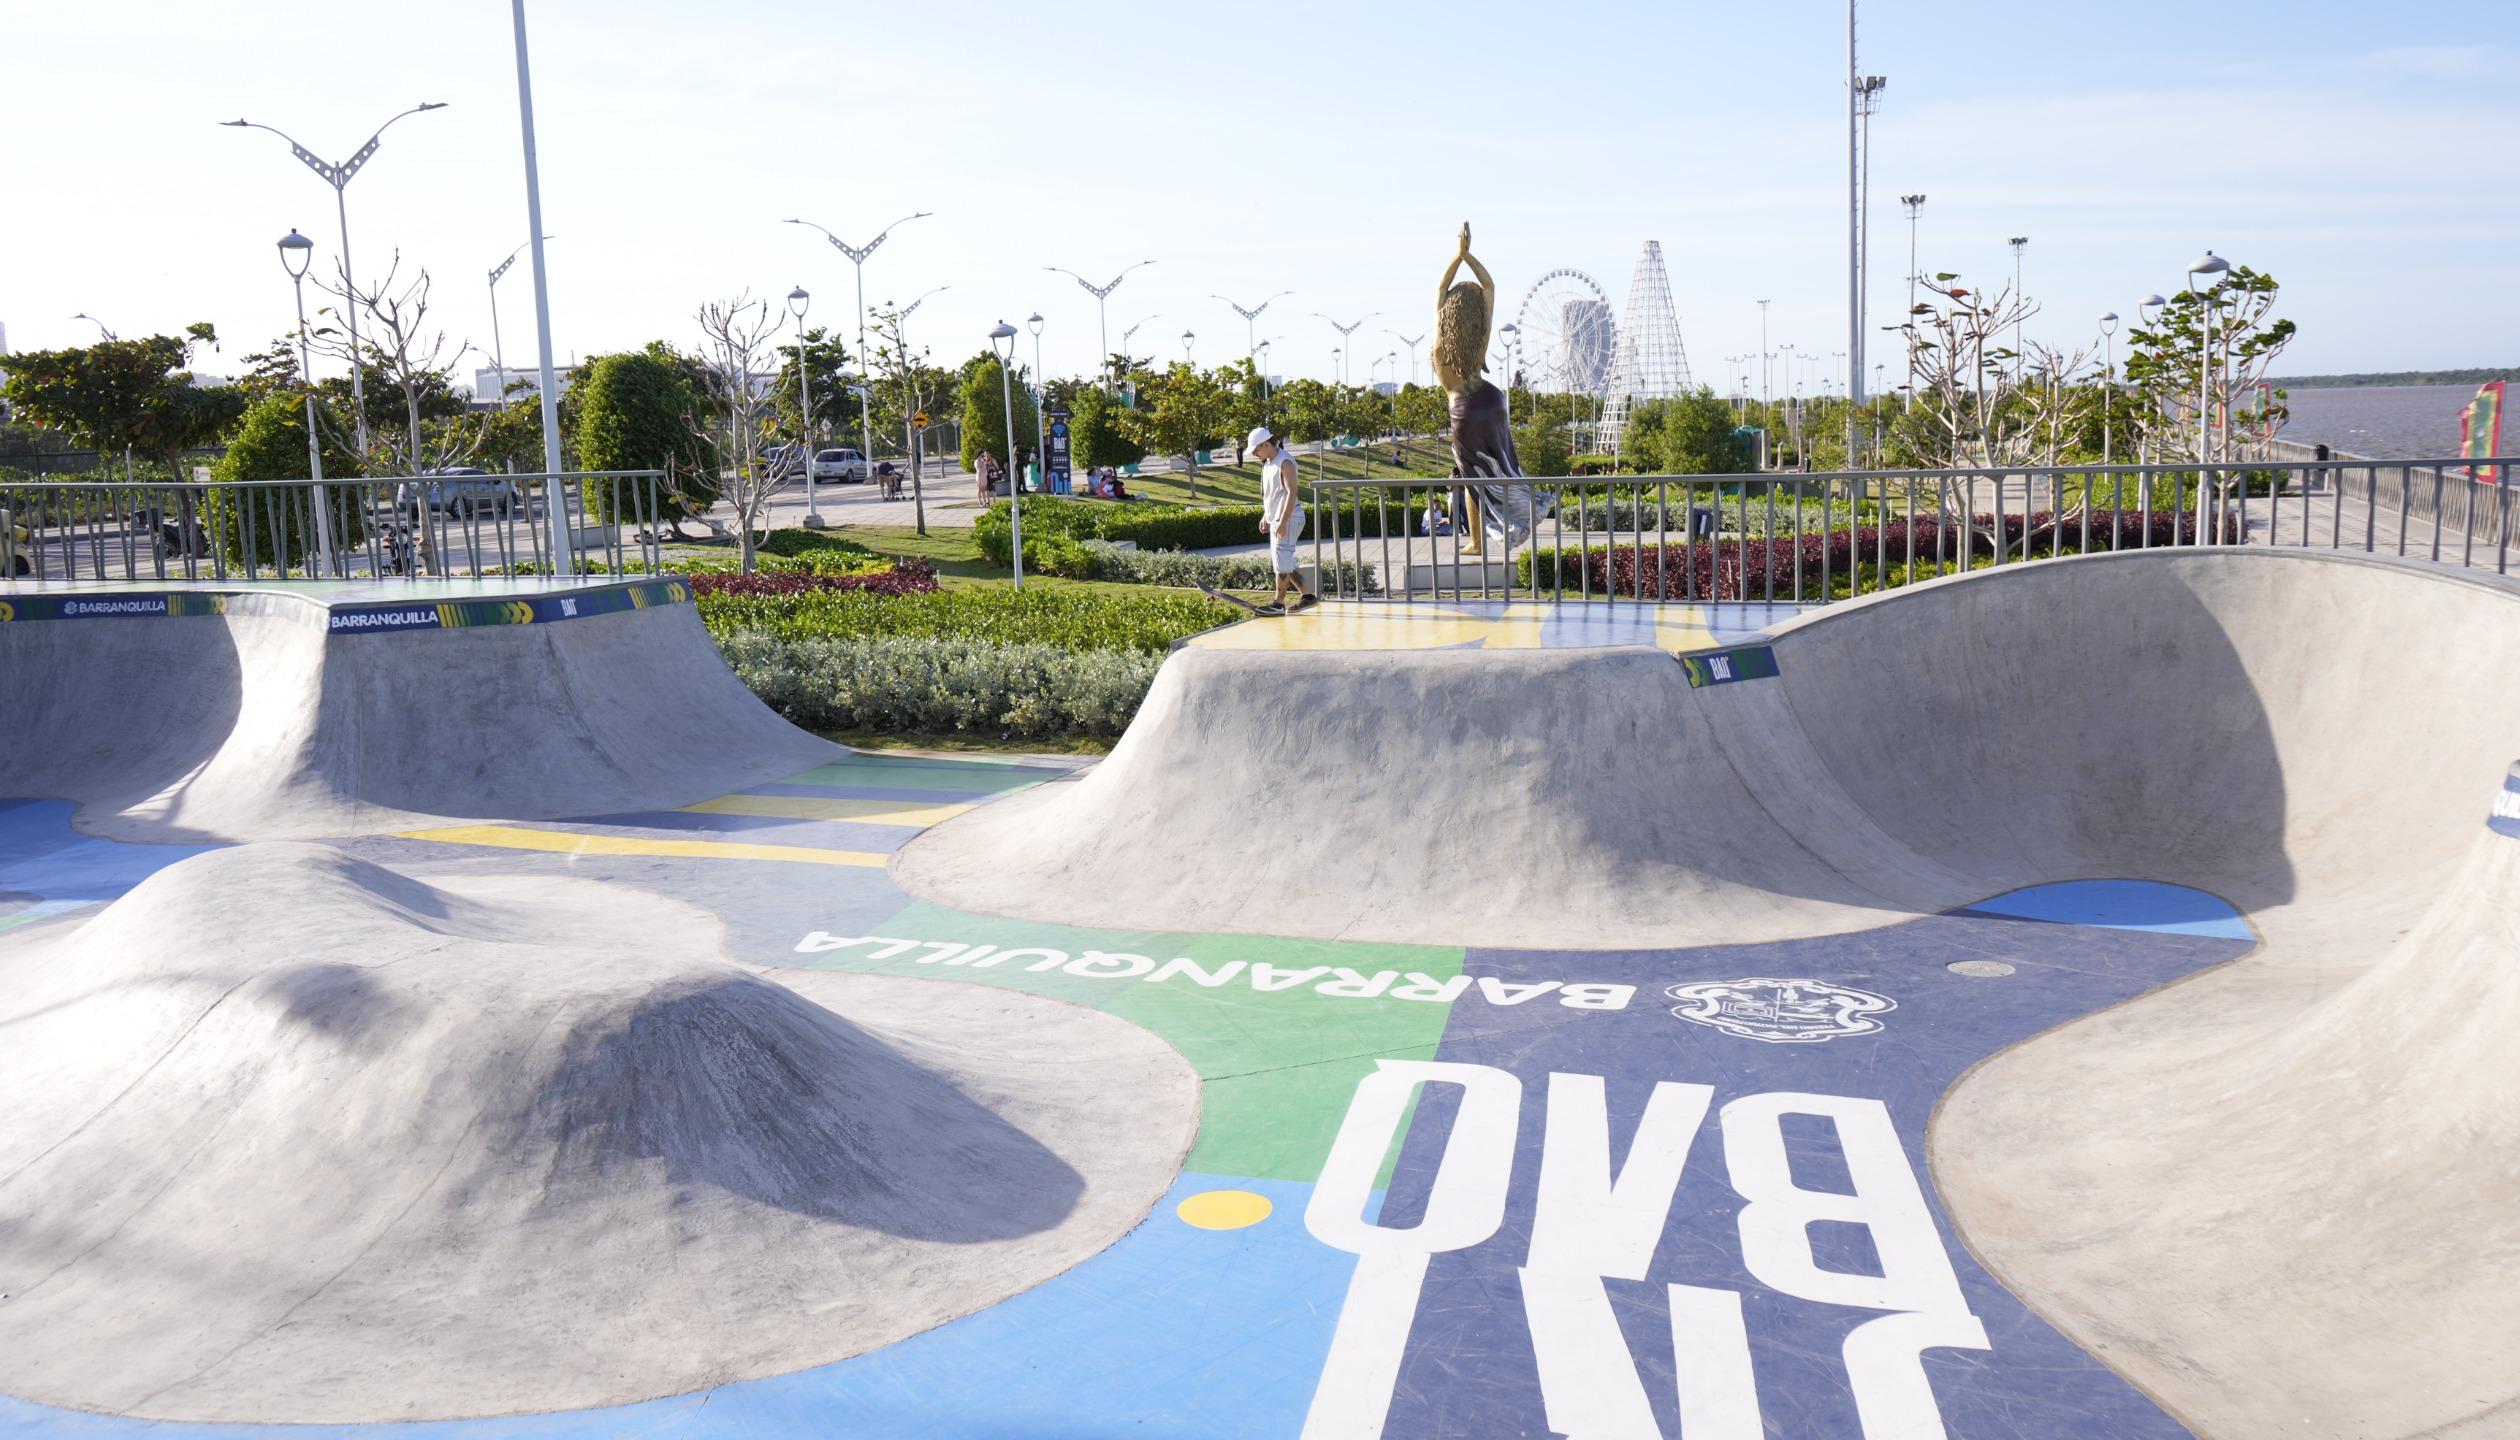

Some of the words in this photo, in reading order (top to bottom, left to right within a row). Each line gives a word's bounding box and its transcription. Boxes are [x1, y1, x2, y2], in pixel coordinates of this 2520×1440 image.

[79, 600, 166, 613] BARRANQUILLA
[331, 610, 438, 628] BARRANQUILLA
[1708, 656, 1731, 681] BAQ
[793, 930, 1638, 1011] BARRANQUILLA
[1303, 1058, 1971, 1313] BAQ
